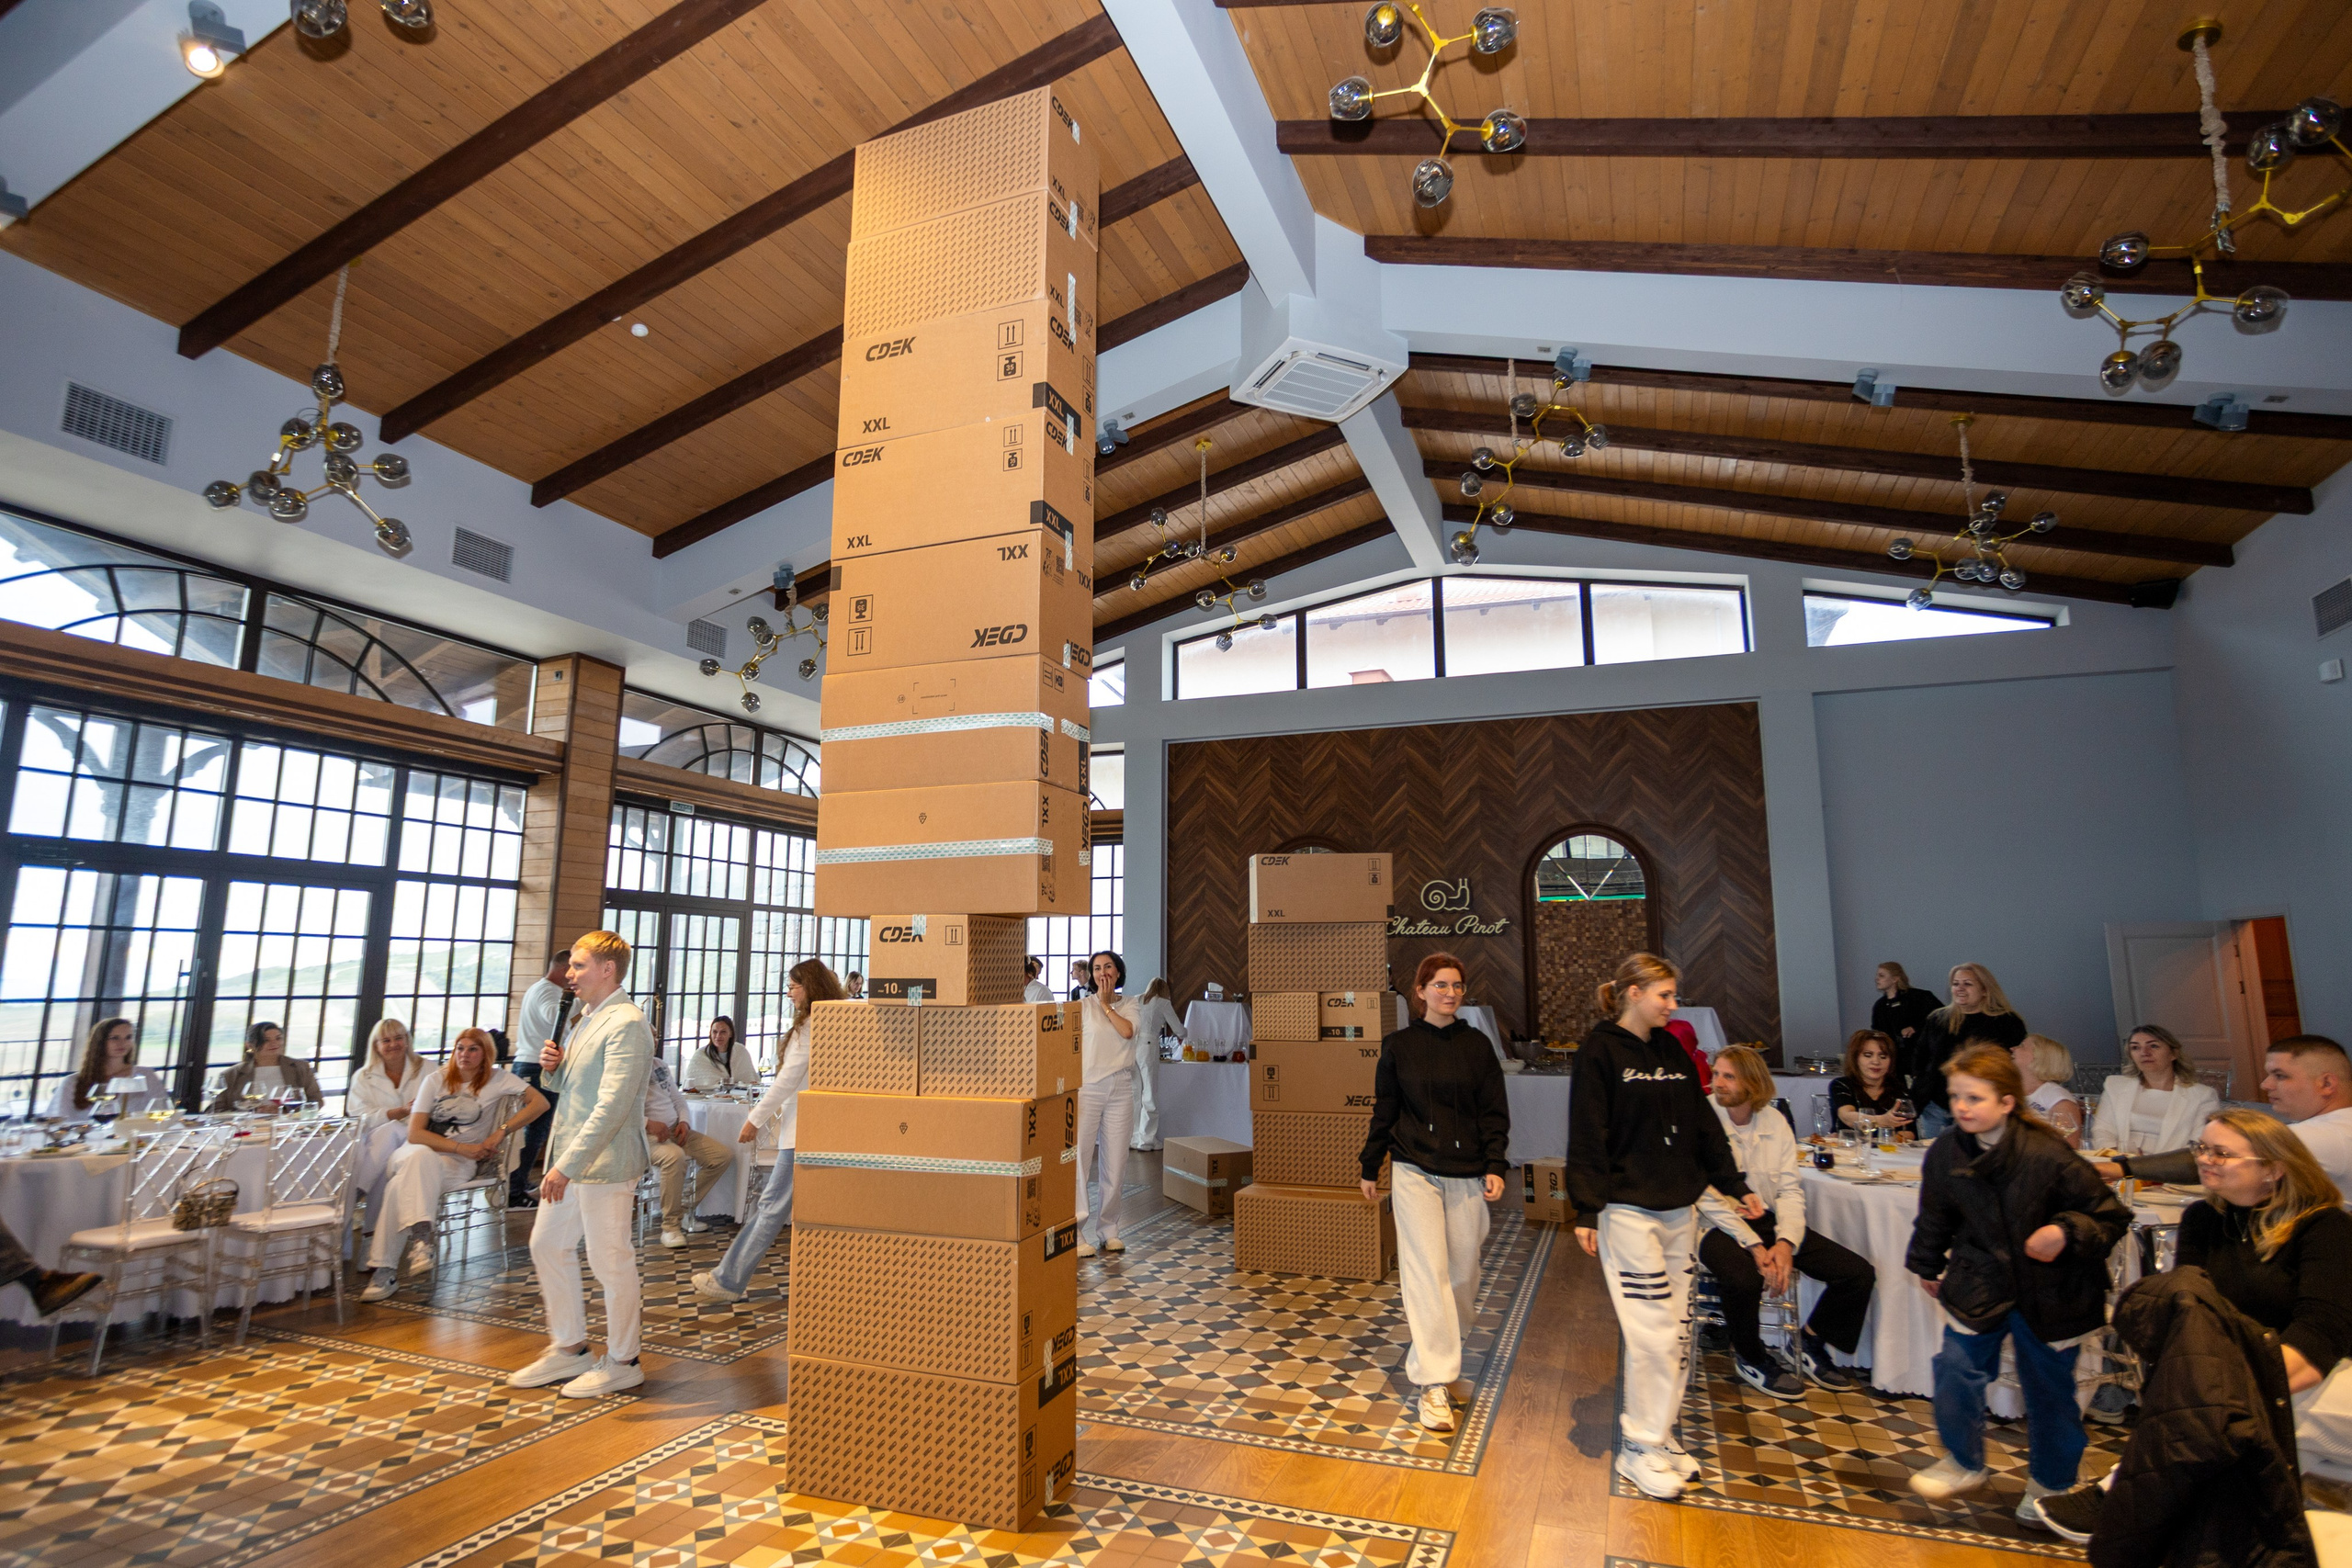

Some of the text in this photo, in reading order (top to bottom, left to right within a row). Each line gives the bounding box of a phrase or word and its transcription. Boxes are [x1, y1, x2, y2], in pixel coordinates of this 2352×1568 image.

[1052, 175, 1067, 201] XXL
[1050, 284, 1064, 309] XXL
[1050, 316, 1075, 354] CDEK
[865, 337, 917, 362] CDEK
[1048, 390, 1064, 417] XXL
[863, 417, 890, 434] XXL
[842, 446, 885, 468] CDEK
[1046, 509, 1060, 531] XXL
[847, 535, 872, 549] XXL
[997, 544, 1029, 561] XXL
[1077, 570, 1091, 591] XXL
[970, 624, 1028, 649] CDEK
[1261, 856, 1291, 866] CDEK
[1268, 909, 1285, 918] XXL
[1386, 914, 1510, 935] Chateau Pinot
[884, 982, 899, 994] 10
[1331, 1028, 1340, 1036] 10
[1358, 1048, 1378, 1058] XXL
[1028, 1105, 1036, 1145] XXL
[1549, 1171, 1558, 1198] CDE
[1059, 1229, 1075, 1248] XXL
[1051, 1325, 1076, 1356] CDEK
[1058, 1362, 1075, 1385] XXL
